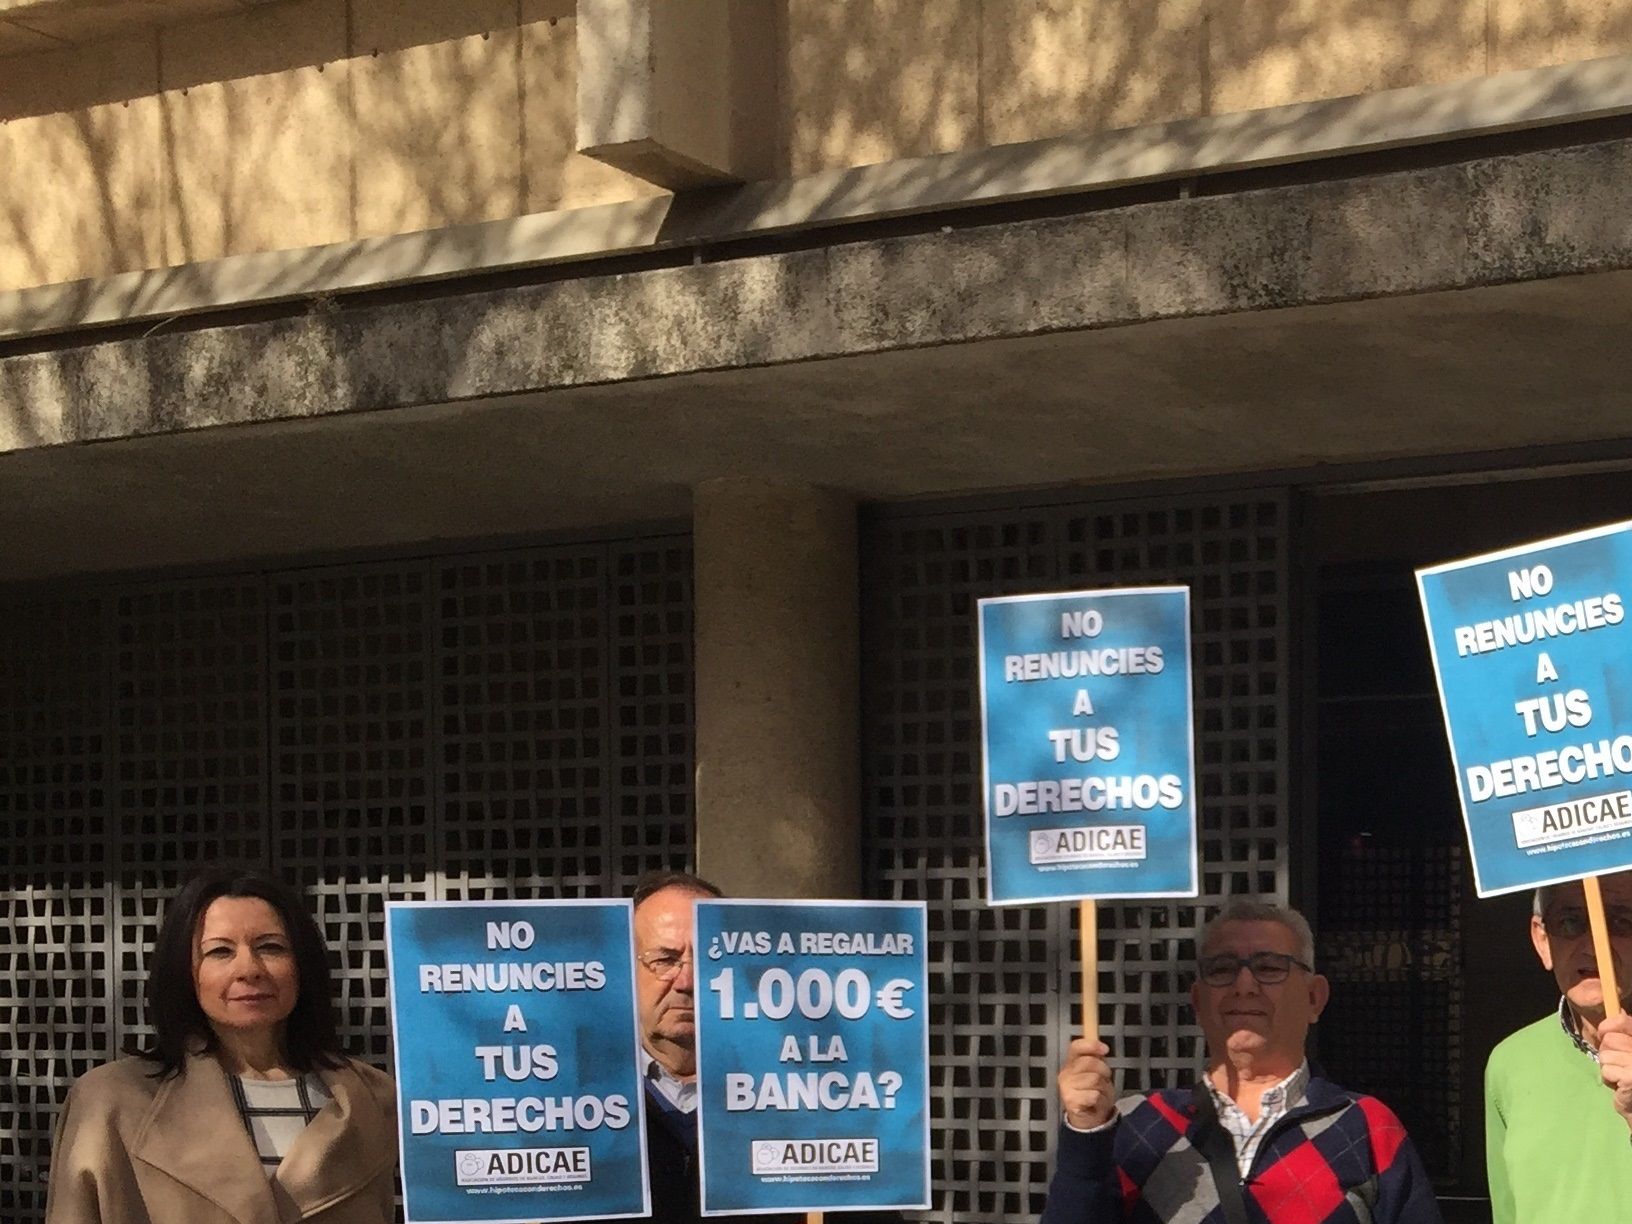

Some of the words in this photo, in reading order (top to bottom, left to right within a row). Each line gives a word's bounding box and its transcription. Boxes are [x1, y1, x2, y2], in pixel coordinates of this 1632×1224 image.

[1508, 565, 1553, 601] NO
[1062, 610, 1103, 639] NO
[1455, 593, 1624, 657] RENUNCIES
[1006, 646, 1165, 682] RENUNCIES
[1537, 653, 1558, 683] A
[1073, 689, 1094, 716] A
[1515, 689, 1592, 736] TUS
[1049, 727, 1120, 763] TUS
[995, 775, 1183, 817] DERECHOS
[1543, 795, 1631, 833] ADICAE
[1056, 829, 1142, 853] ADICAE
[486, 921, 534, 950] NO
[709, 931, 771, 960] ¿VAS
[777, 932, 795, 955] A
[800, 932, 913, 956] REGALAR
[420, 962, 606, 993] RENUNCIES
[504, 1004, 527, 1032] A
[475, 1045, 558, 1081] TUS
[780, 1035, 800, 1062] A
[810, 1035, 848, 1062] LA
[727, 1071, 902, 1111] BANCA?
[411, 1094, 631, 1135] DERECHOS
[487, 1151, 586, 1175] ADICAE
[782, 1142, 874, 1164] ADICAE
